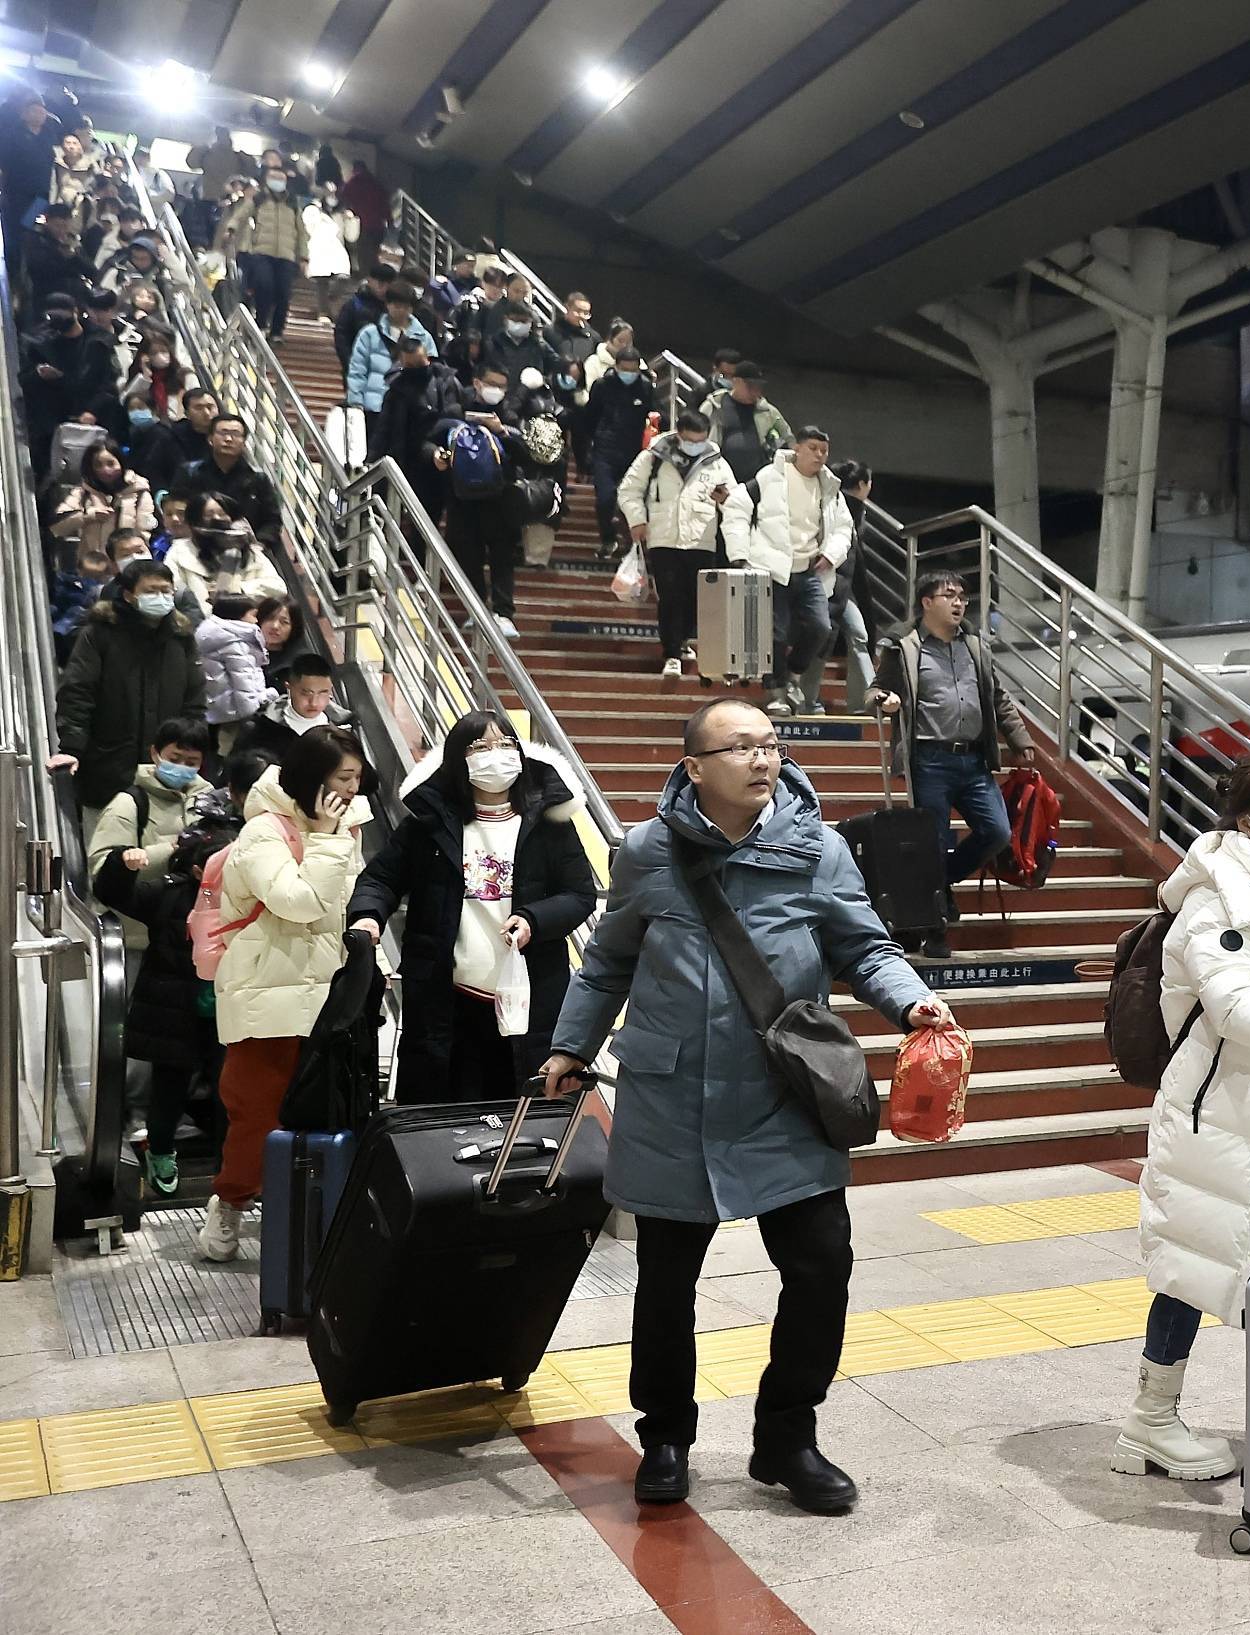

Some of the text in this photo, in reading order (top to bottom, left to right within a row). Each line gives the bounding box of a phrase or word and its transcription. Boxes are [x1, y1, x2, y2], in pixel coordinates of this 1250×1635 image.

[943, 966, 1032, 980] 便捷换乘由此上行
